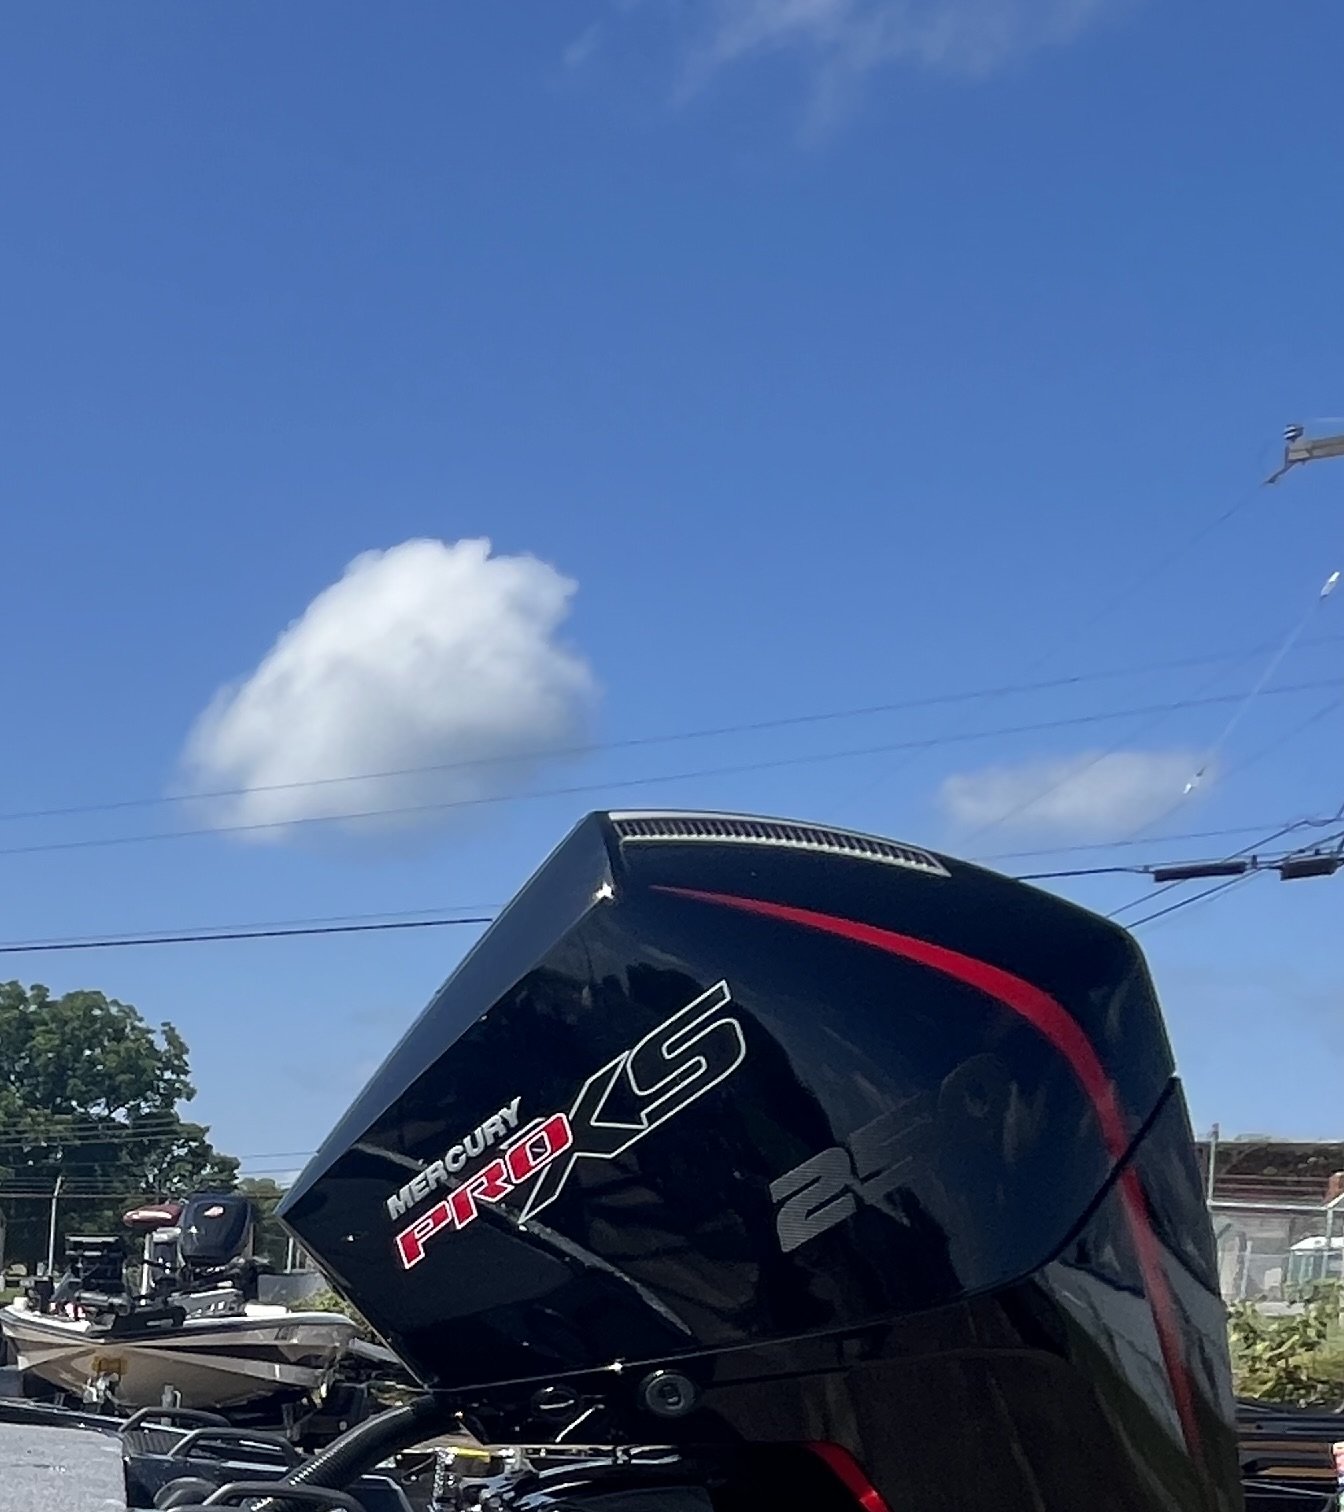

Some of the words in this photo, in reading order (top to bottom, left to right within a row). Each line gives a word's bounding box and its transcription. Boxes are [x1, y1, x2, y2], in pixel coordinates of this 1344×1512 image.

[384, 1096, 522, 1221] MERCURY
[395, 1112, 573, 1270] PRO
[499, 979, 746, 1224] XS
